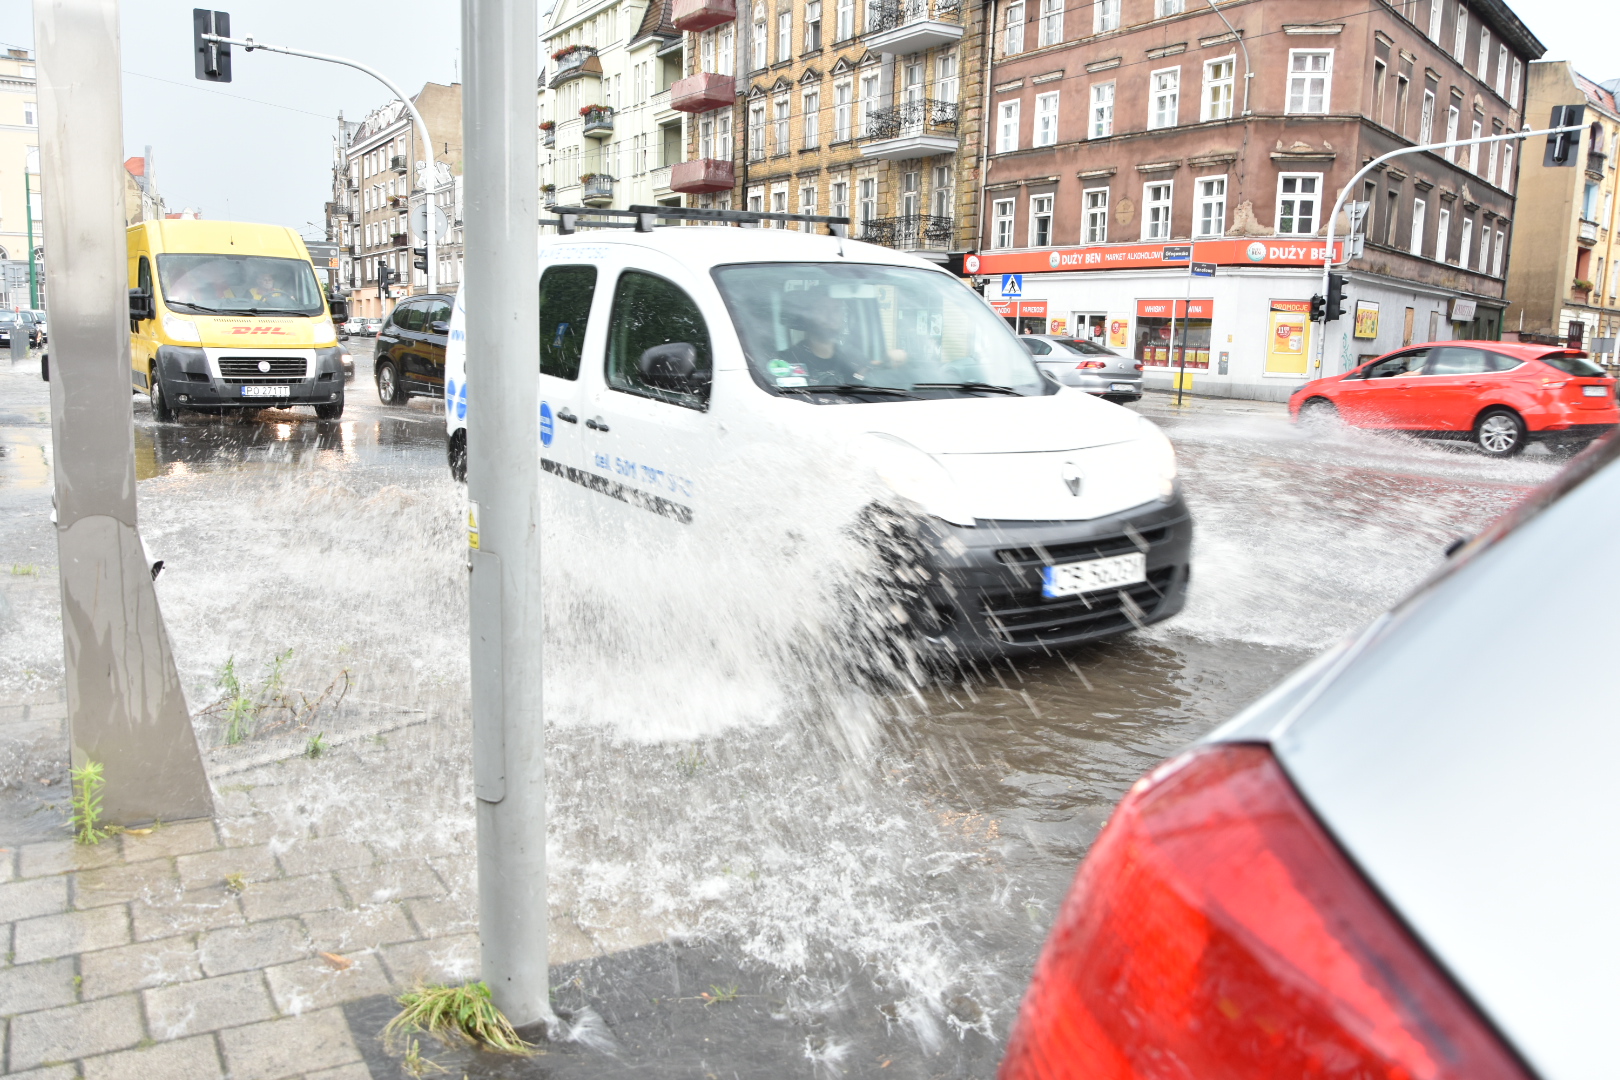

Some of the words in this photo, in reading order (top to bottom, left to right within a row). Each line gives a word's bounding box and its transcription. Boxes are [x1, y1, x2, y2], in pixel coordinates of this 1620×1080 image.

[1269, 244, 1307, 259] DUŻY
[1061, 252, 1084, 265] DUŻY
[1085, 252, 1101, 264] BEN
[1105, 252, 1127, 261] MARKET
[1022, 306, 1045, 314] PAPIEROSY
[1144, 305, 1166, 313] WHISKY
[1273, 303, 1309, 311] PROMOCJE
[231, 326, 286, 335] DHL
[246, 386, 260, 395] PO
[262, 386, 289, 395] 271TT
